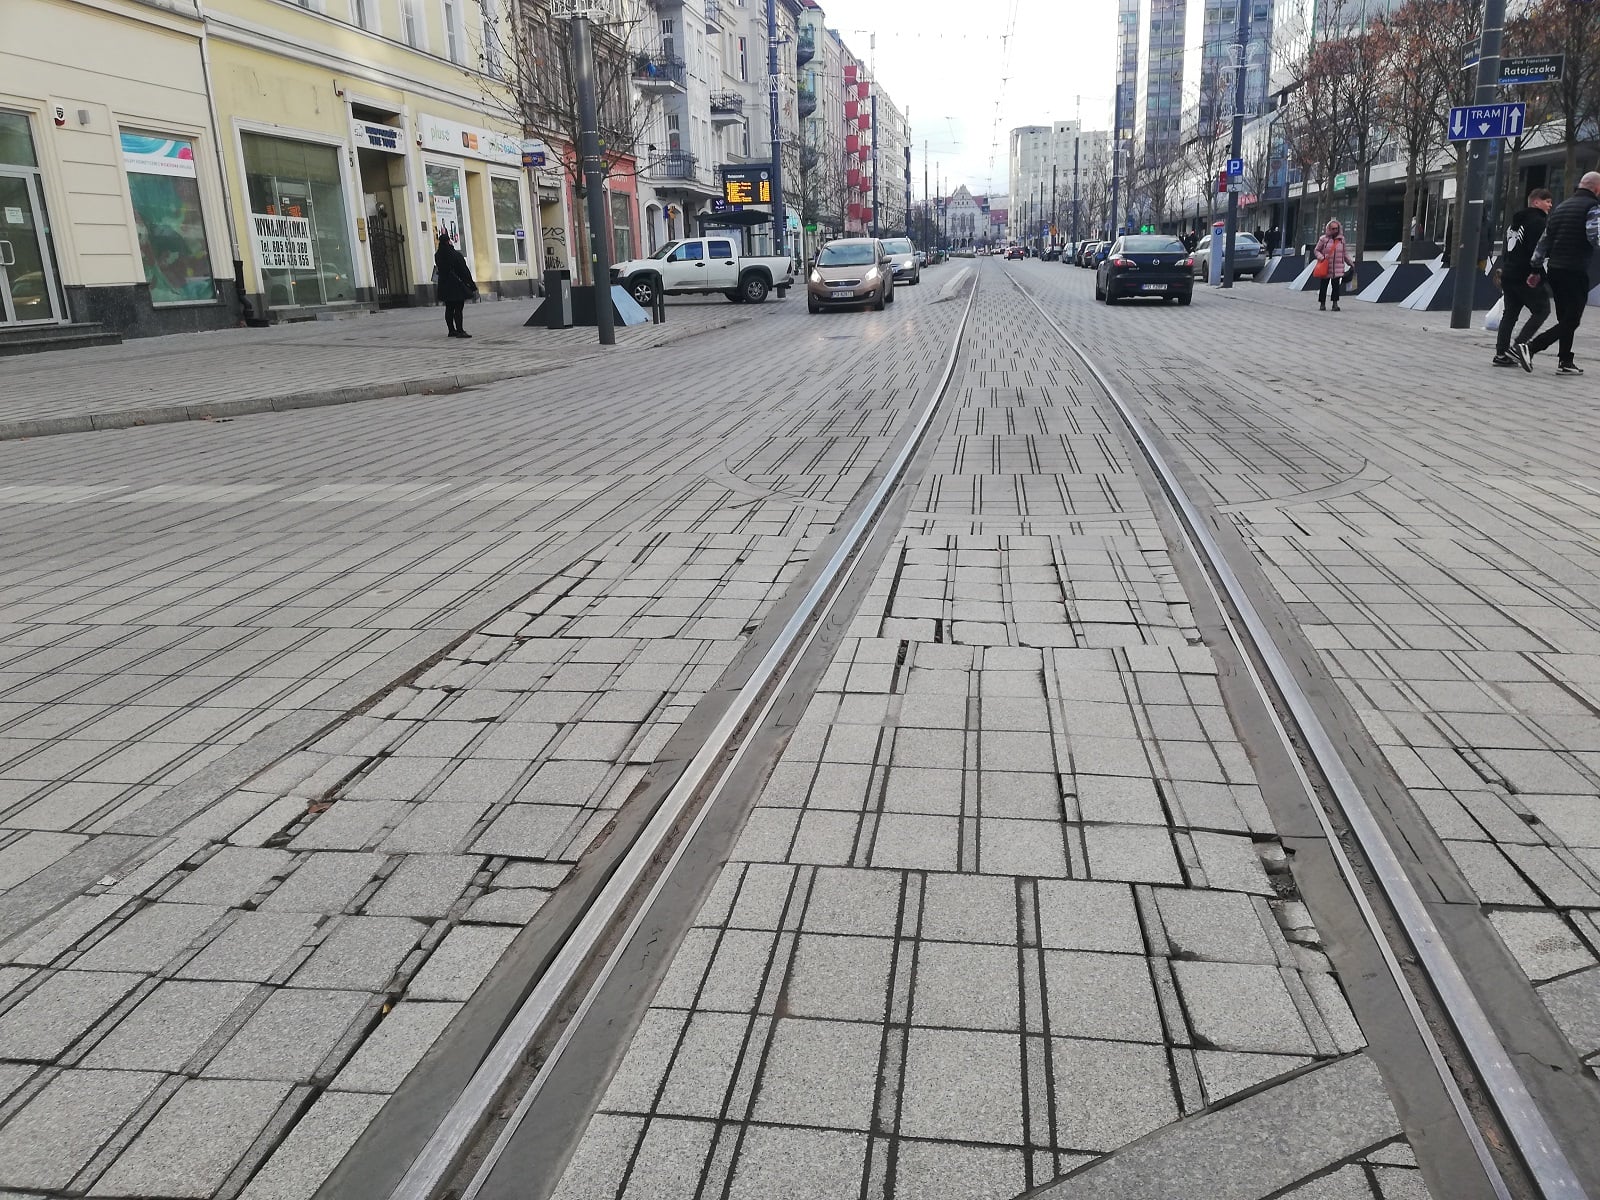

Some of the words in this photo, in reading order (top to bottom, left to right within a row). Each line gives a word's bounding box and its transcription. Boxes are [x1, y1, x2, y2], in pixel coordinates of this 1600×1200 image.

[1504, 64, 1556, 77] Ratajczaka
[1471, 109, 1501, 119] TRAM
[1230, 160, 1240, 174] P
[288, 220, 308, 239] LOKAL
[260, 240, 271, 253] Tel.
